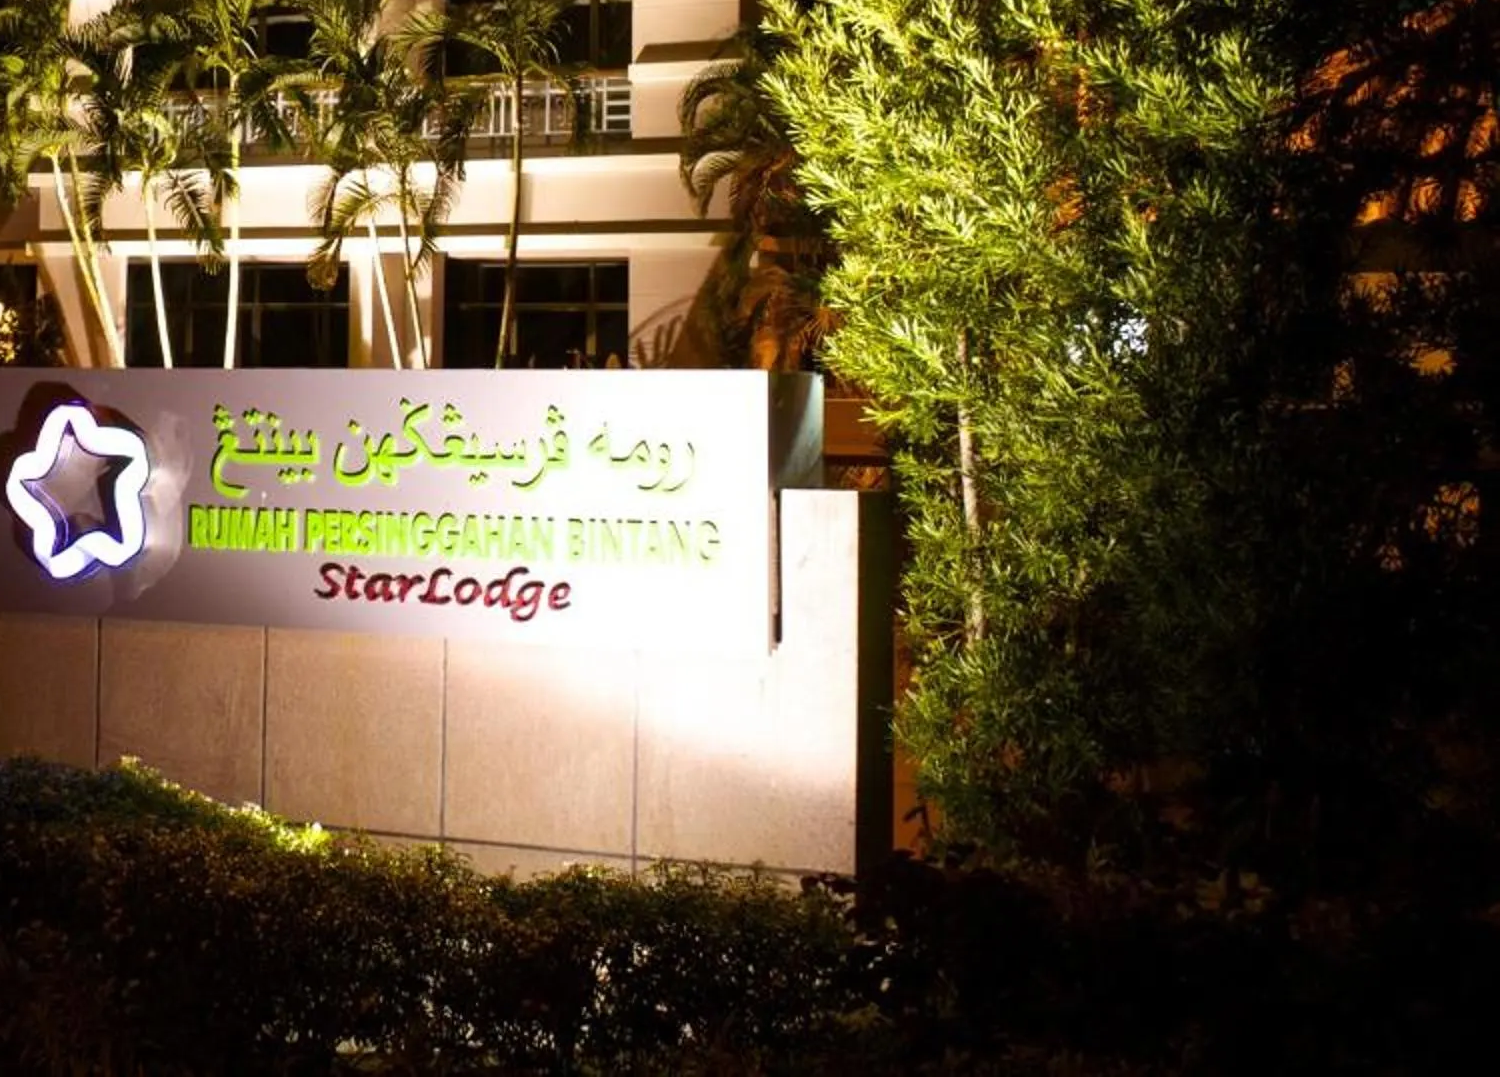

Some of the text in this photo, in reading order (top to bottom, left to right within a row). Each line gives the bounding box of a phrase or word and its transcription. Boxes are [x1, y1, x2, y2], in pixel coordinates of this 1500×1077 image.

[188, 504, 721, 564] RUMAH PERSINGGAHAN BINTANG
[313, 562, 571, 622] StarLodge
